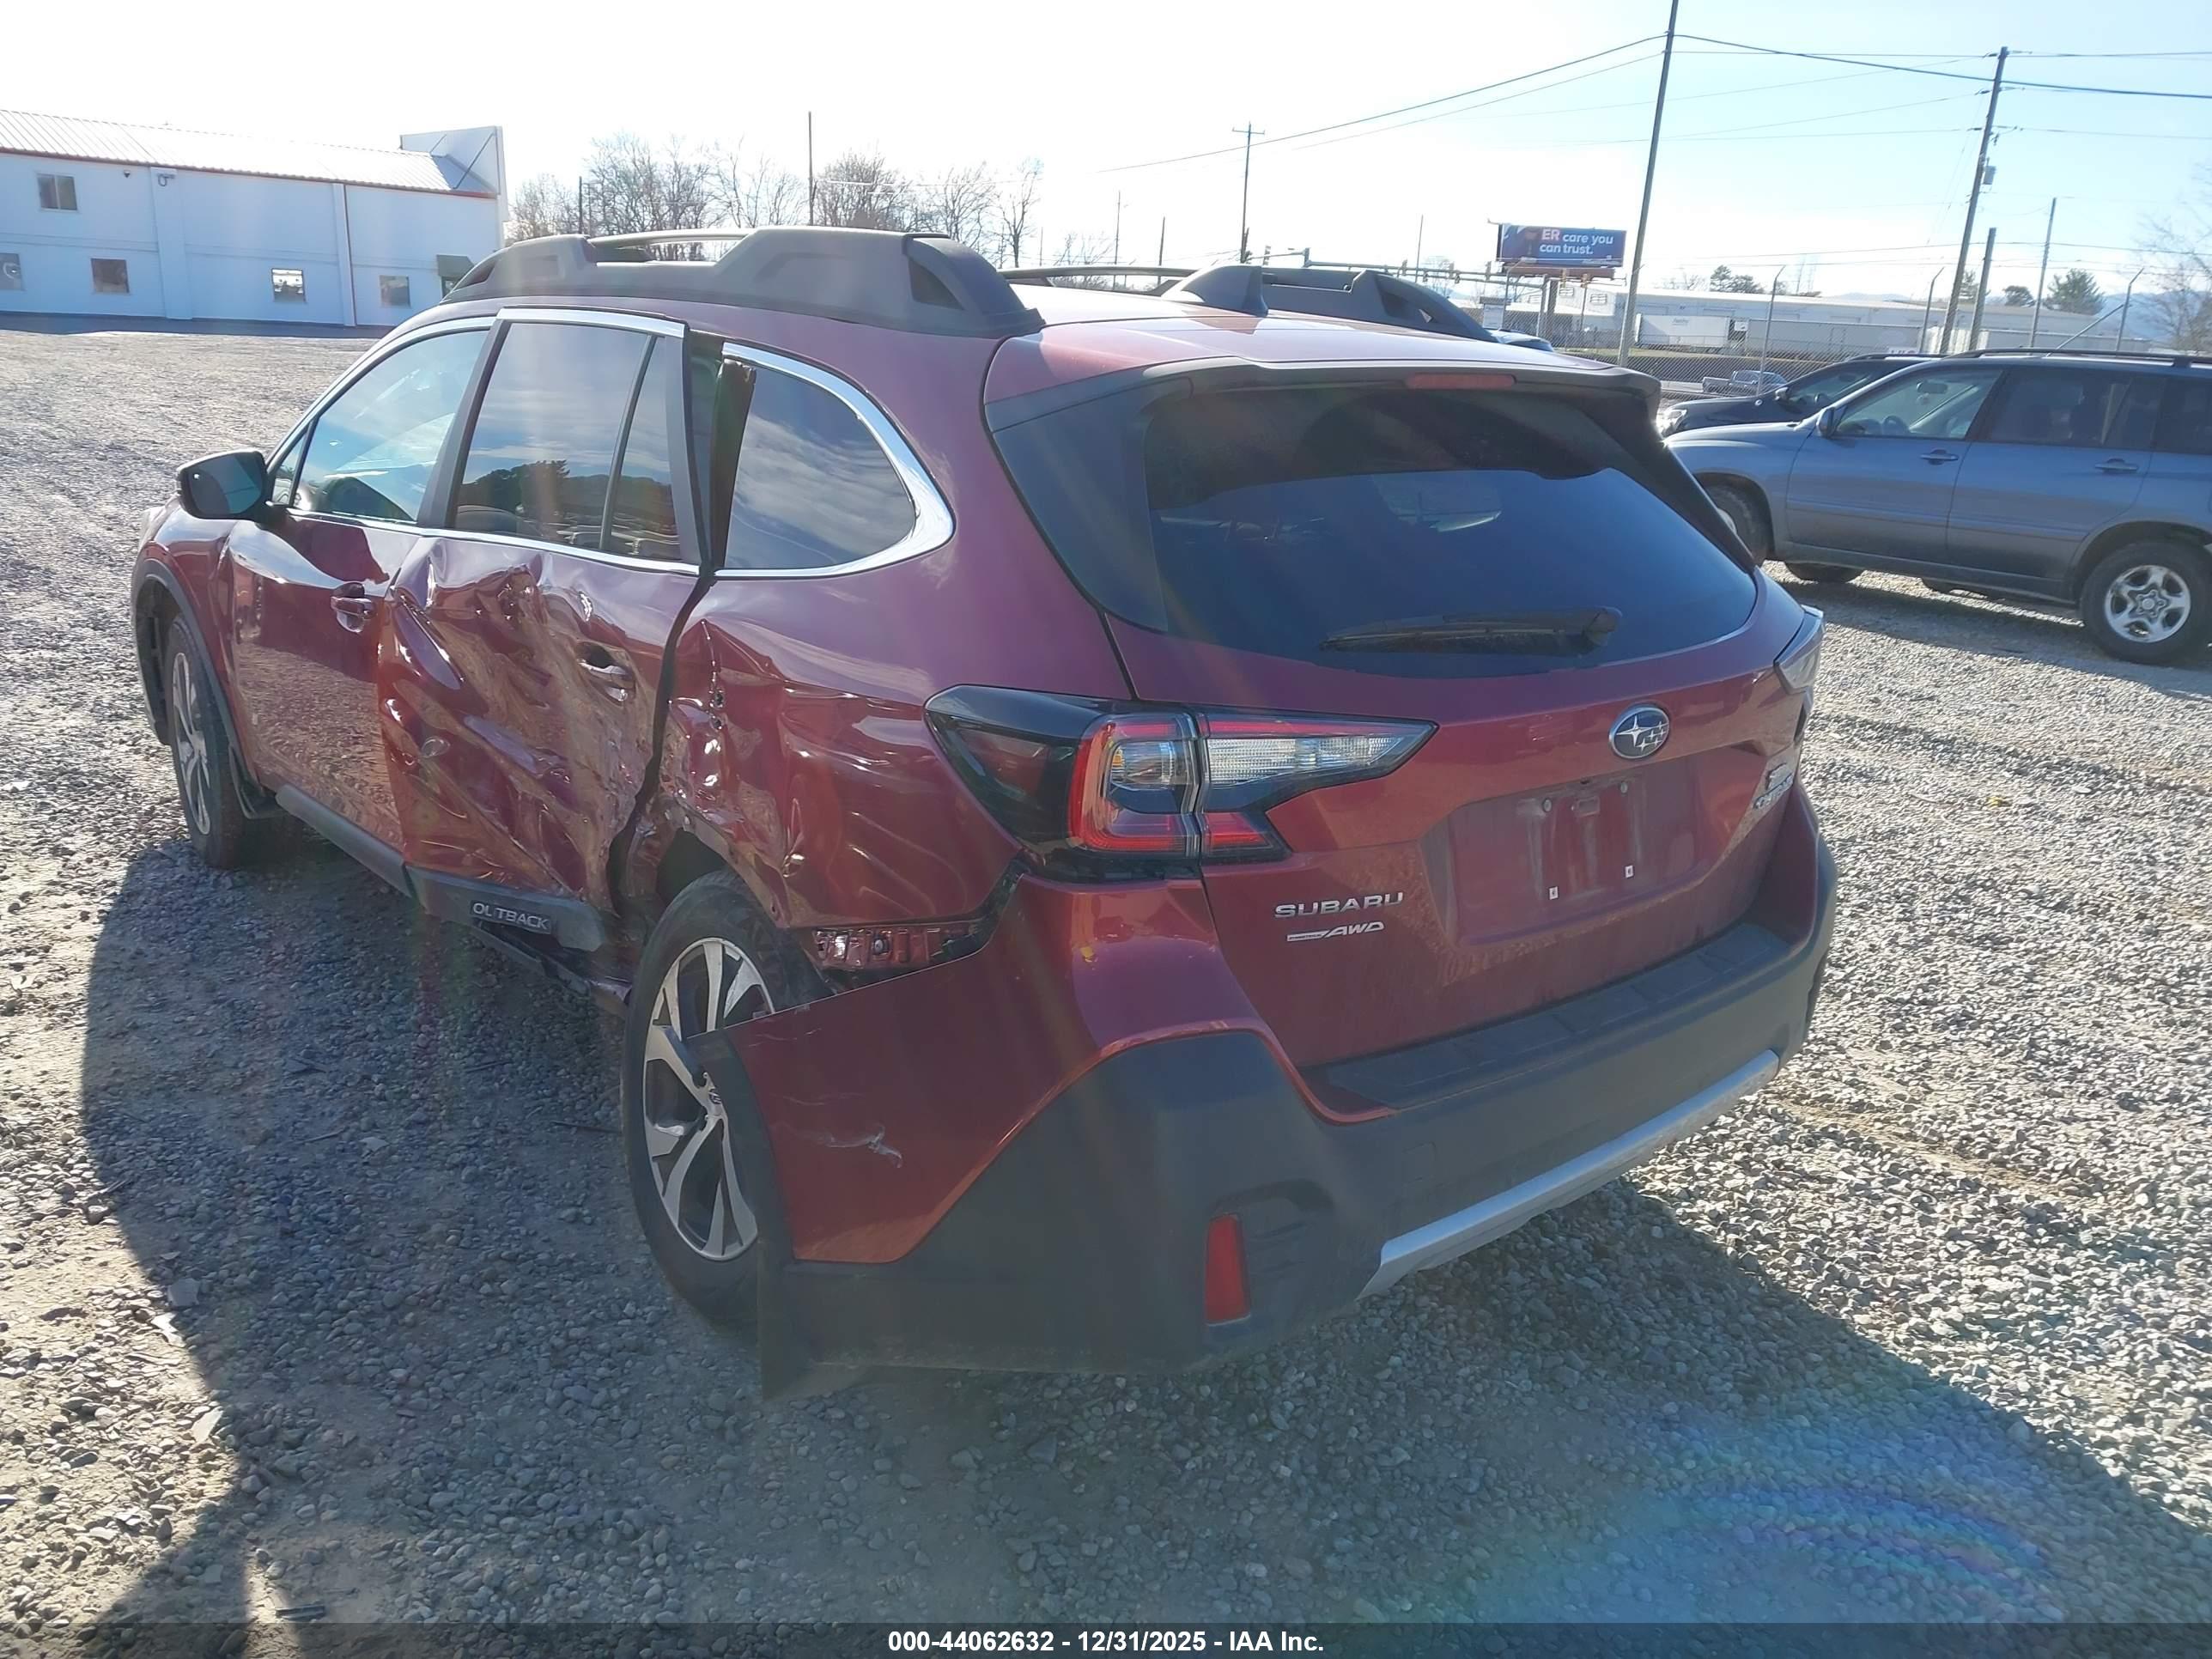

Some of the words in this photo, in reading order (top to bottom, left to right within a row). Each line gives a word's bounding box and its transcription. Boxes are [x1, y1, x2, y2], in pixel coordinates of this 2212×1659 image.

[1541, 228, 1560, 240] ER
[1562, 233, 1589, 243] care
[1591, 234, 1613, 246] you
[1540, 243, 1561, 253] can
[1563, 243, 1594, 255] trust.
[1274, 891, 1404, 918] SUBARU
[1324, 921, 1385, 938] AWD
